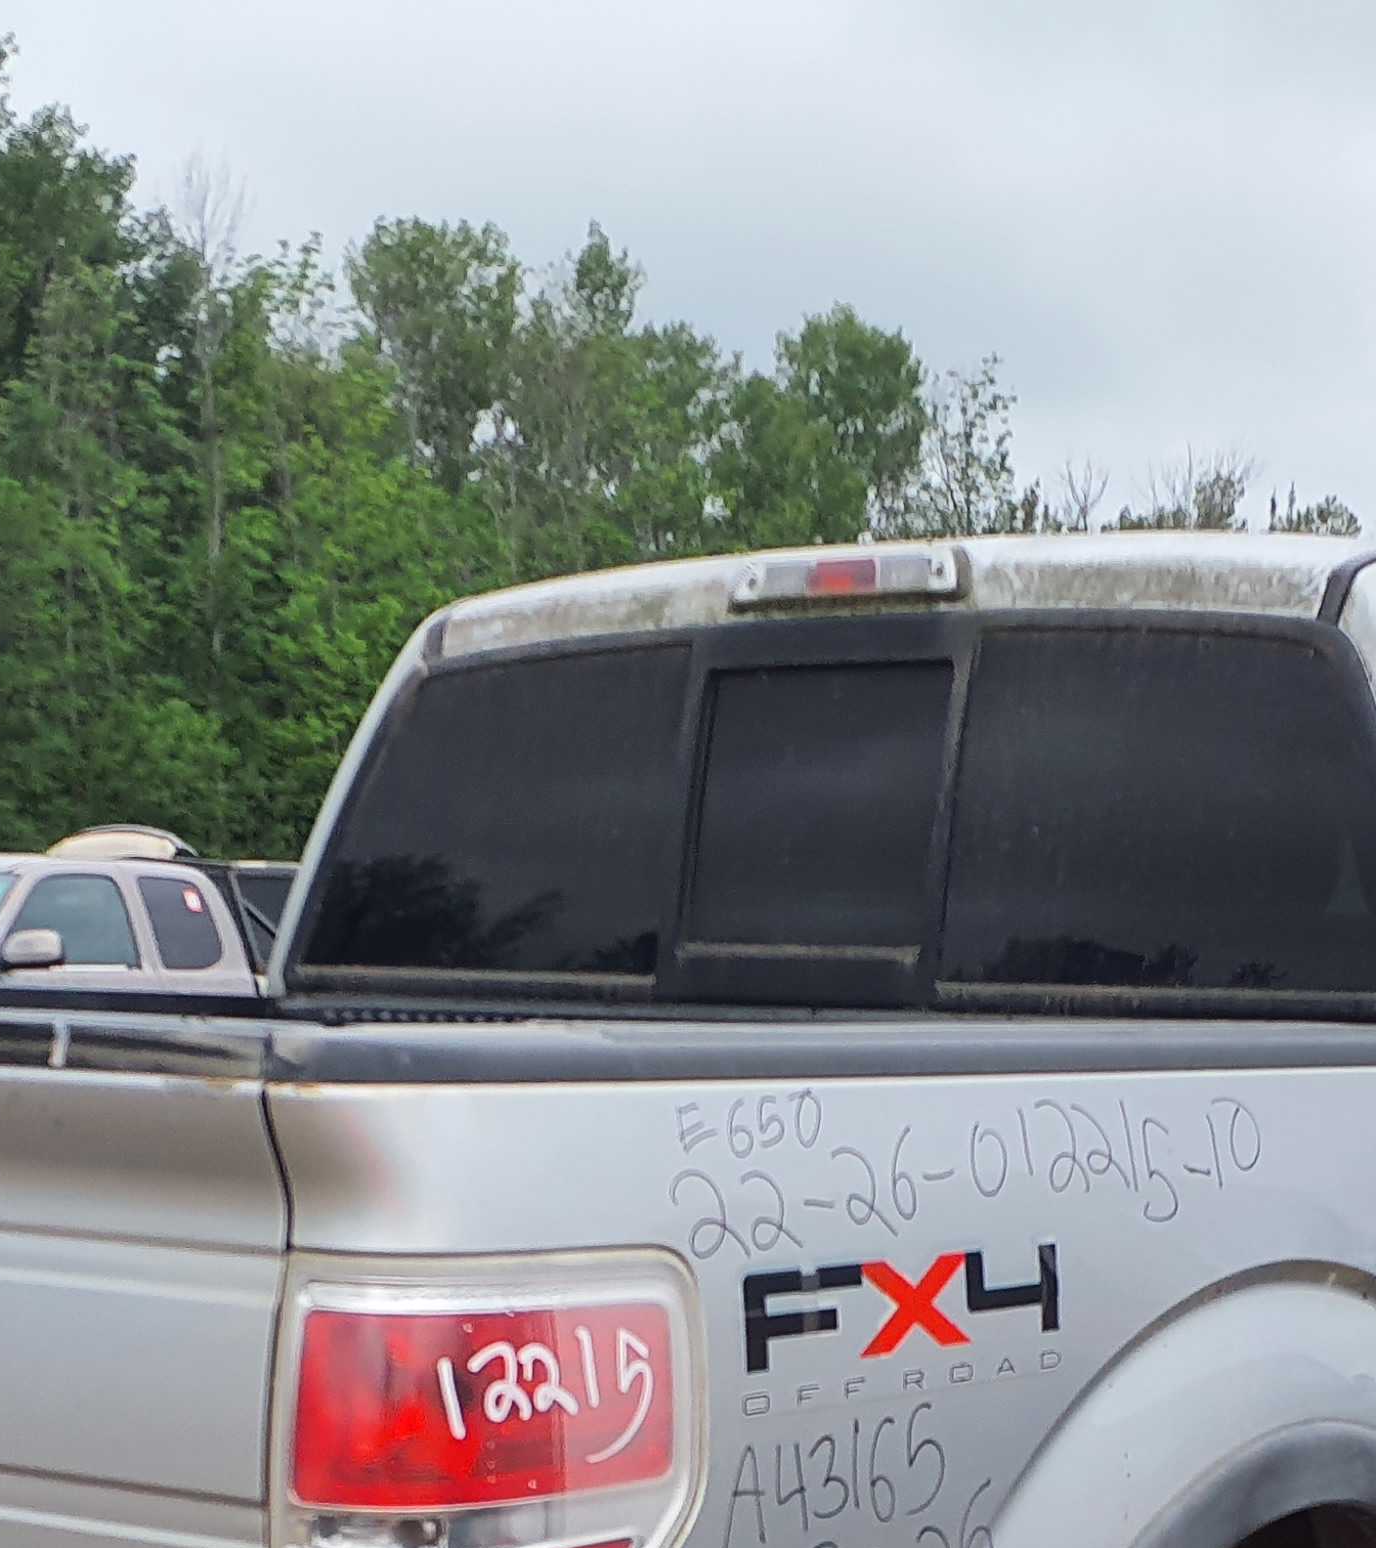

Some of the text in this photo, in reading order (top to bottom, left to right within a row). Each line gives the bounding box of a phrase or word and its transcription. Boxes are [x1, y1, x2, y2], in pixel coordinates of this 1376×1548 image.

[743, 1243, 1060, 1373] FX4
[437, 1326, 654, 1463] 12215
[743, 1376, 867, 1416] OFF
[902, 1351, 1062, 1391] ROAD
